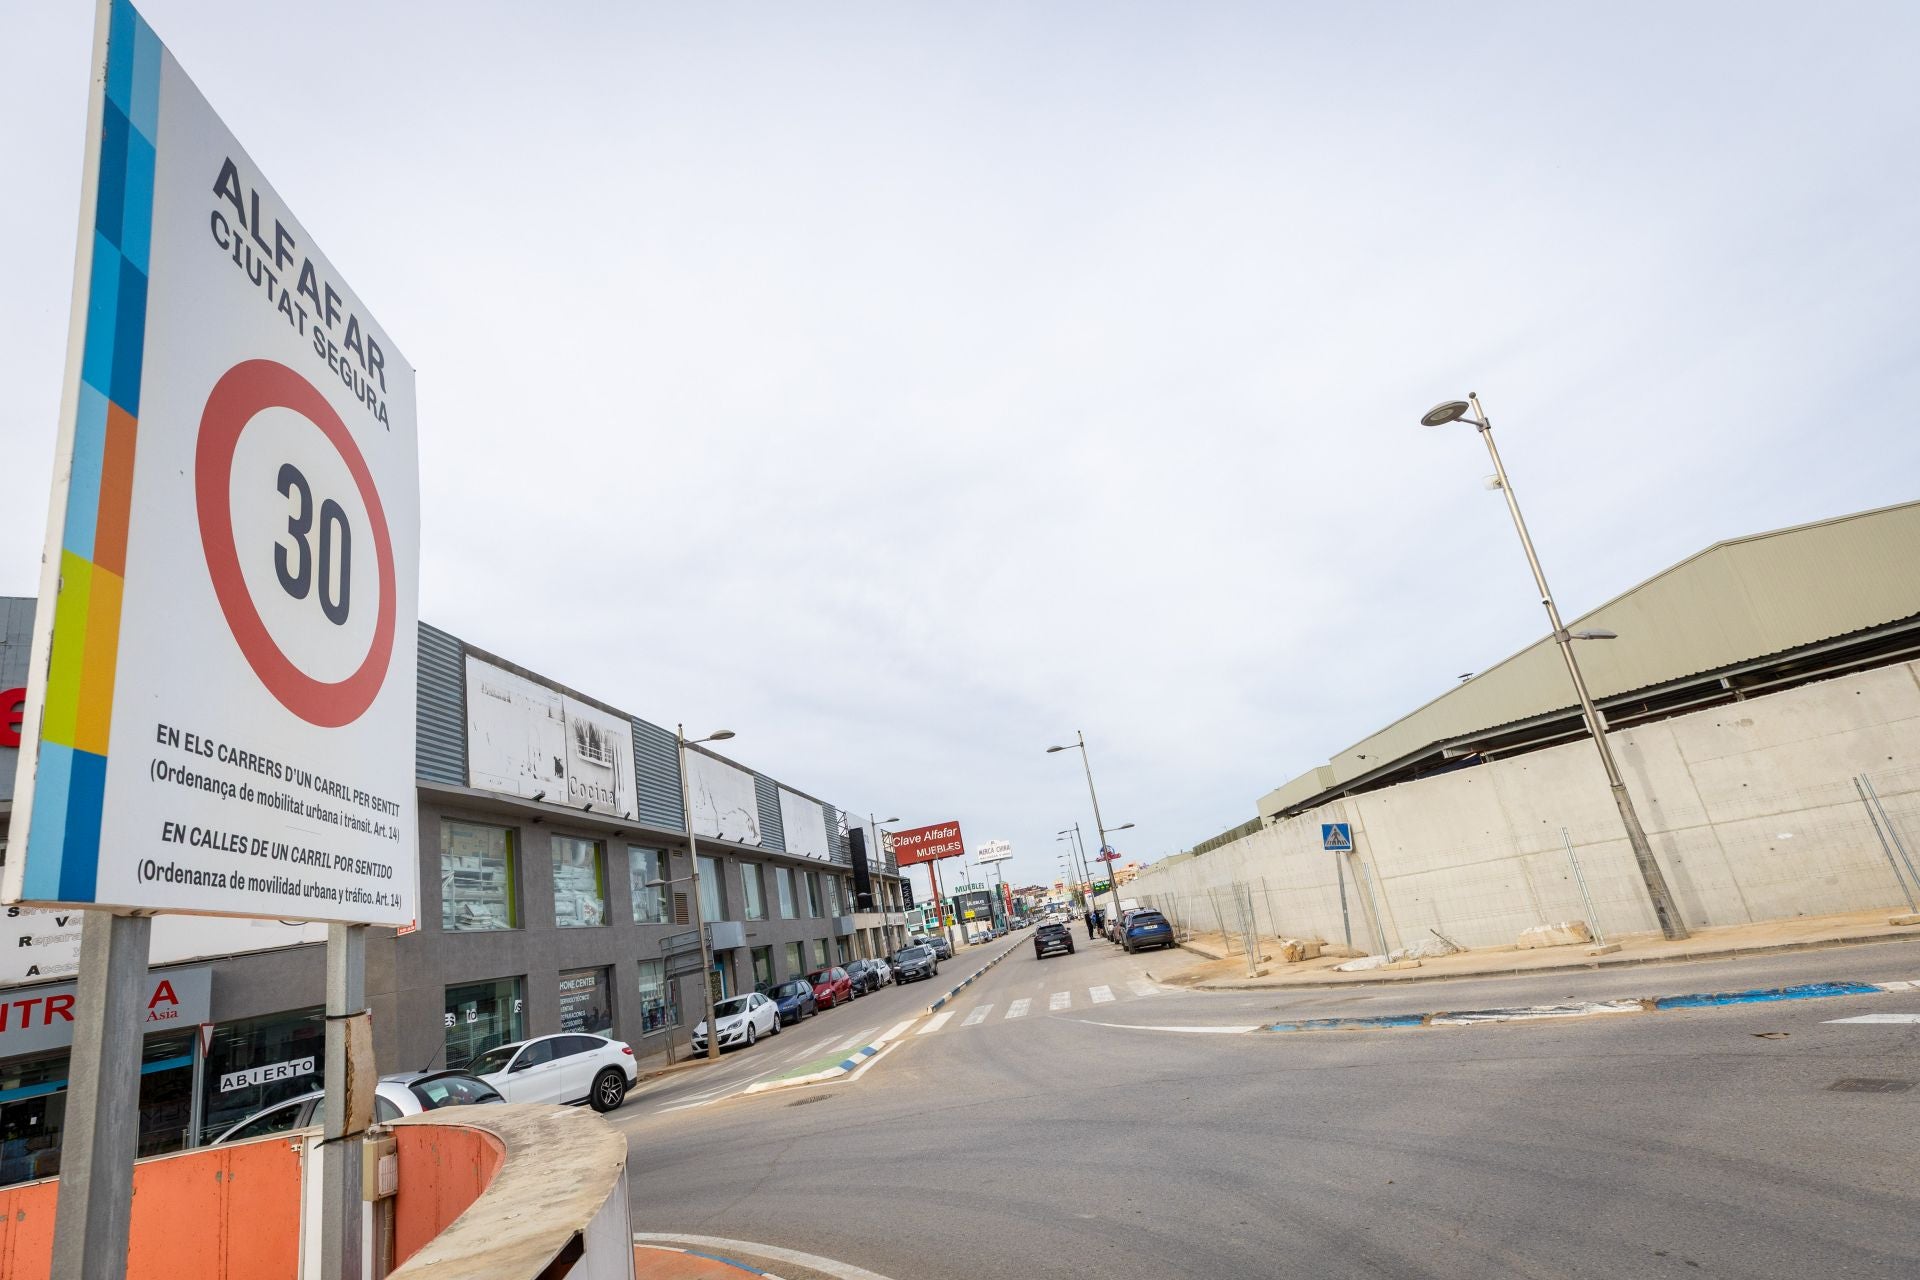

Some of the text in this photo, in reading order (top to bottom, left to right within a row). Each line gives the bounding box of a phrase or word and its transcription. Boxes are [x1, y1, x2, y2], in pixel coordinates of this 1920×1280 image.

[211, 156, 387, 394] ALFAFAR
[210, 210, 390, 432] CIUTAT SEGURA
[274, 463, 352, 626] 30
[156, 723, 401, 818] EN ELS CARRERS D'UN CARRIL PER SENTIT
[570, 776, 615, 804] Cocina
[150, 758, 401, 844] (Ordenança de mobilitat urbana i trànsit. Art. 14)
[161, 821, 394, 880] EN CALLES DE UN CARRIL POR SENTIDO
[893, 827, 957, 847] Clave Alfafar
[916, 842, 961, 857] MUEBLES
[137, 859, 402, 910] (Ordenanza de movilidad urbana y tráfico. Art. 14)
[954, 882, 984, 893] MUEBLES
[560, 977, 595, 990] HOME CENTER
[145, 1007, 178, 1023] Asia
[222, 1060, 313, 1090] ABIERTO
